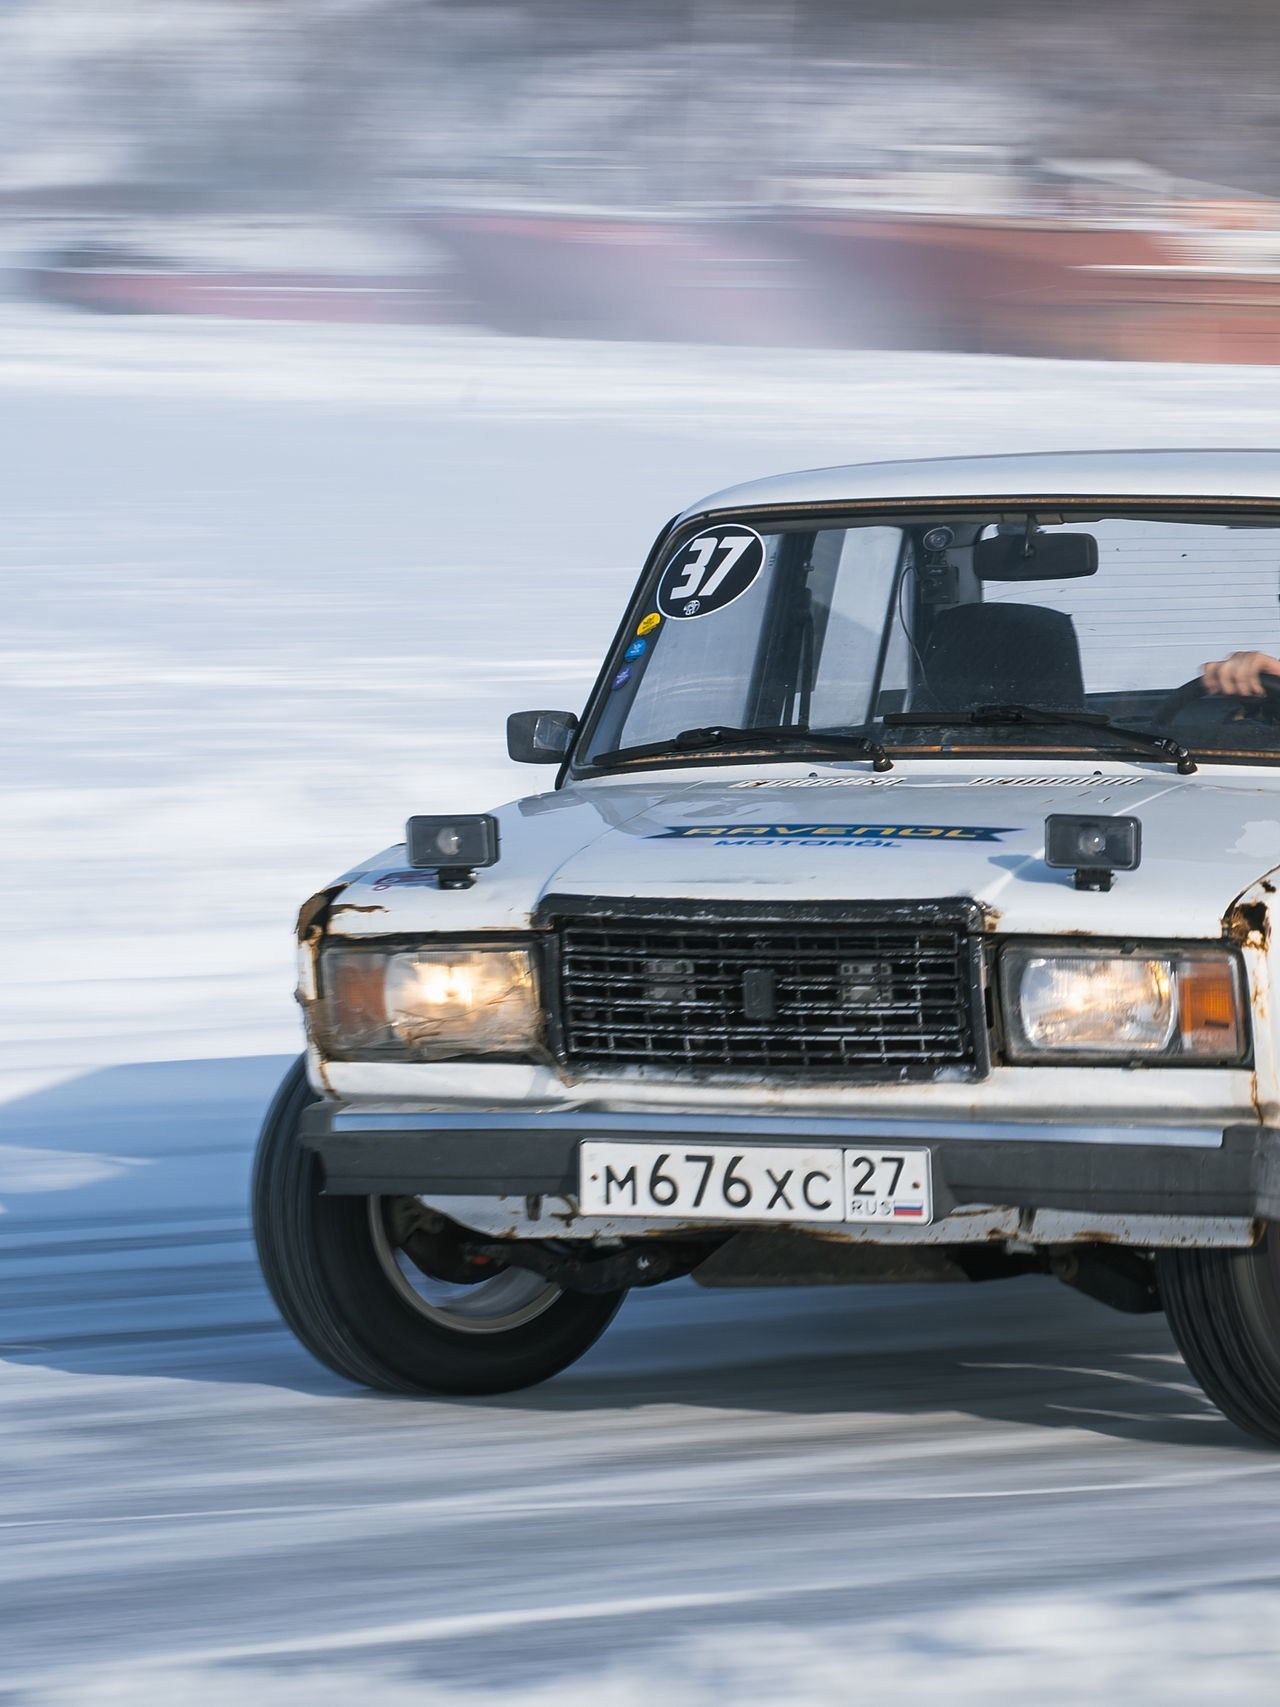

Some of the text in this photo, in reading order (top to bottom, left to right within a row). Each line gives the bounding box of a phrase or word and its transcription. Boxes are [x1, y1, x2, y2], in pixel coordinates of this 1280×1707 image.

[669, 536, 756, 600] 37
[682, 826, 978, 839] RAVENOL
[852, 1156, 905, 1197] 27
[850, 1199, 891, 1217] RUS
